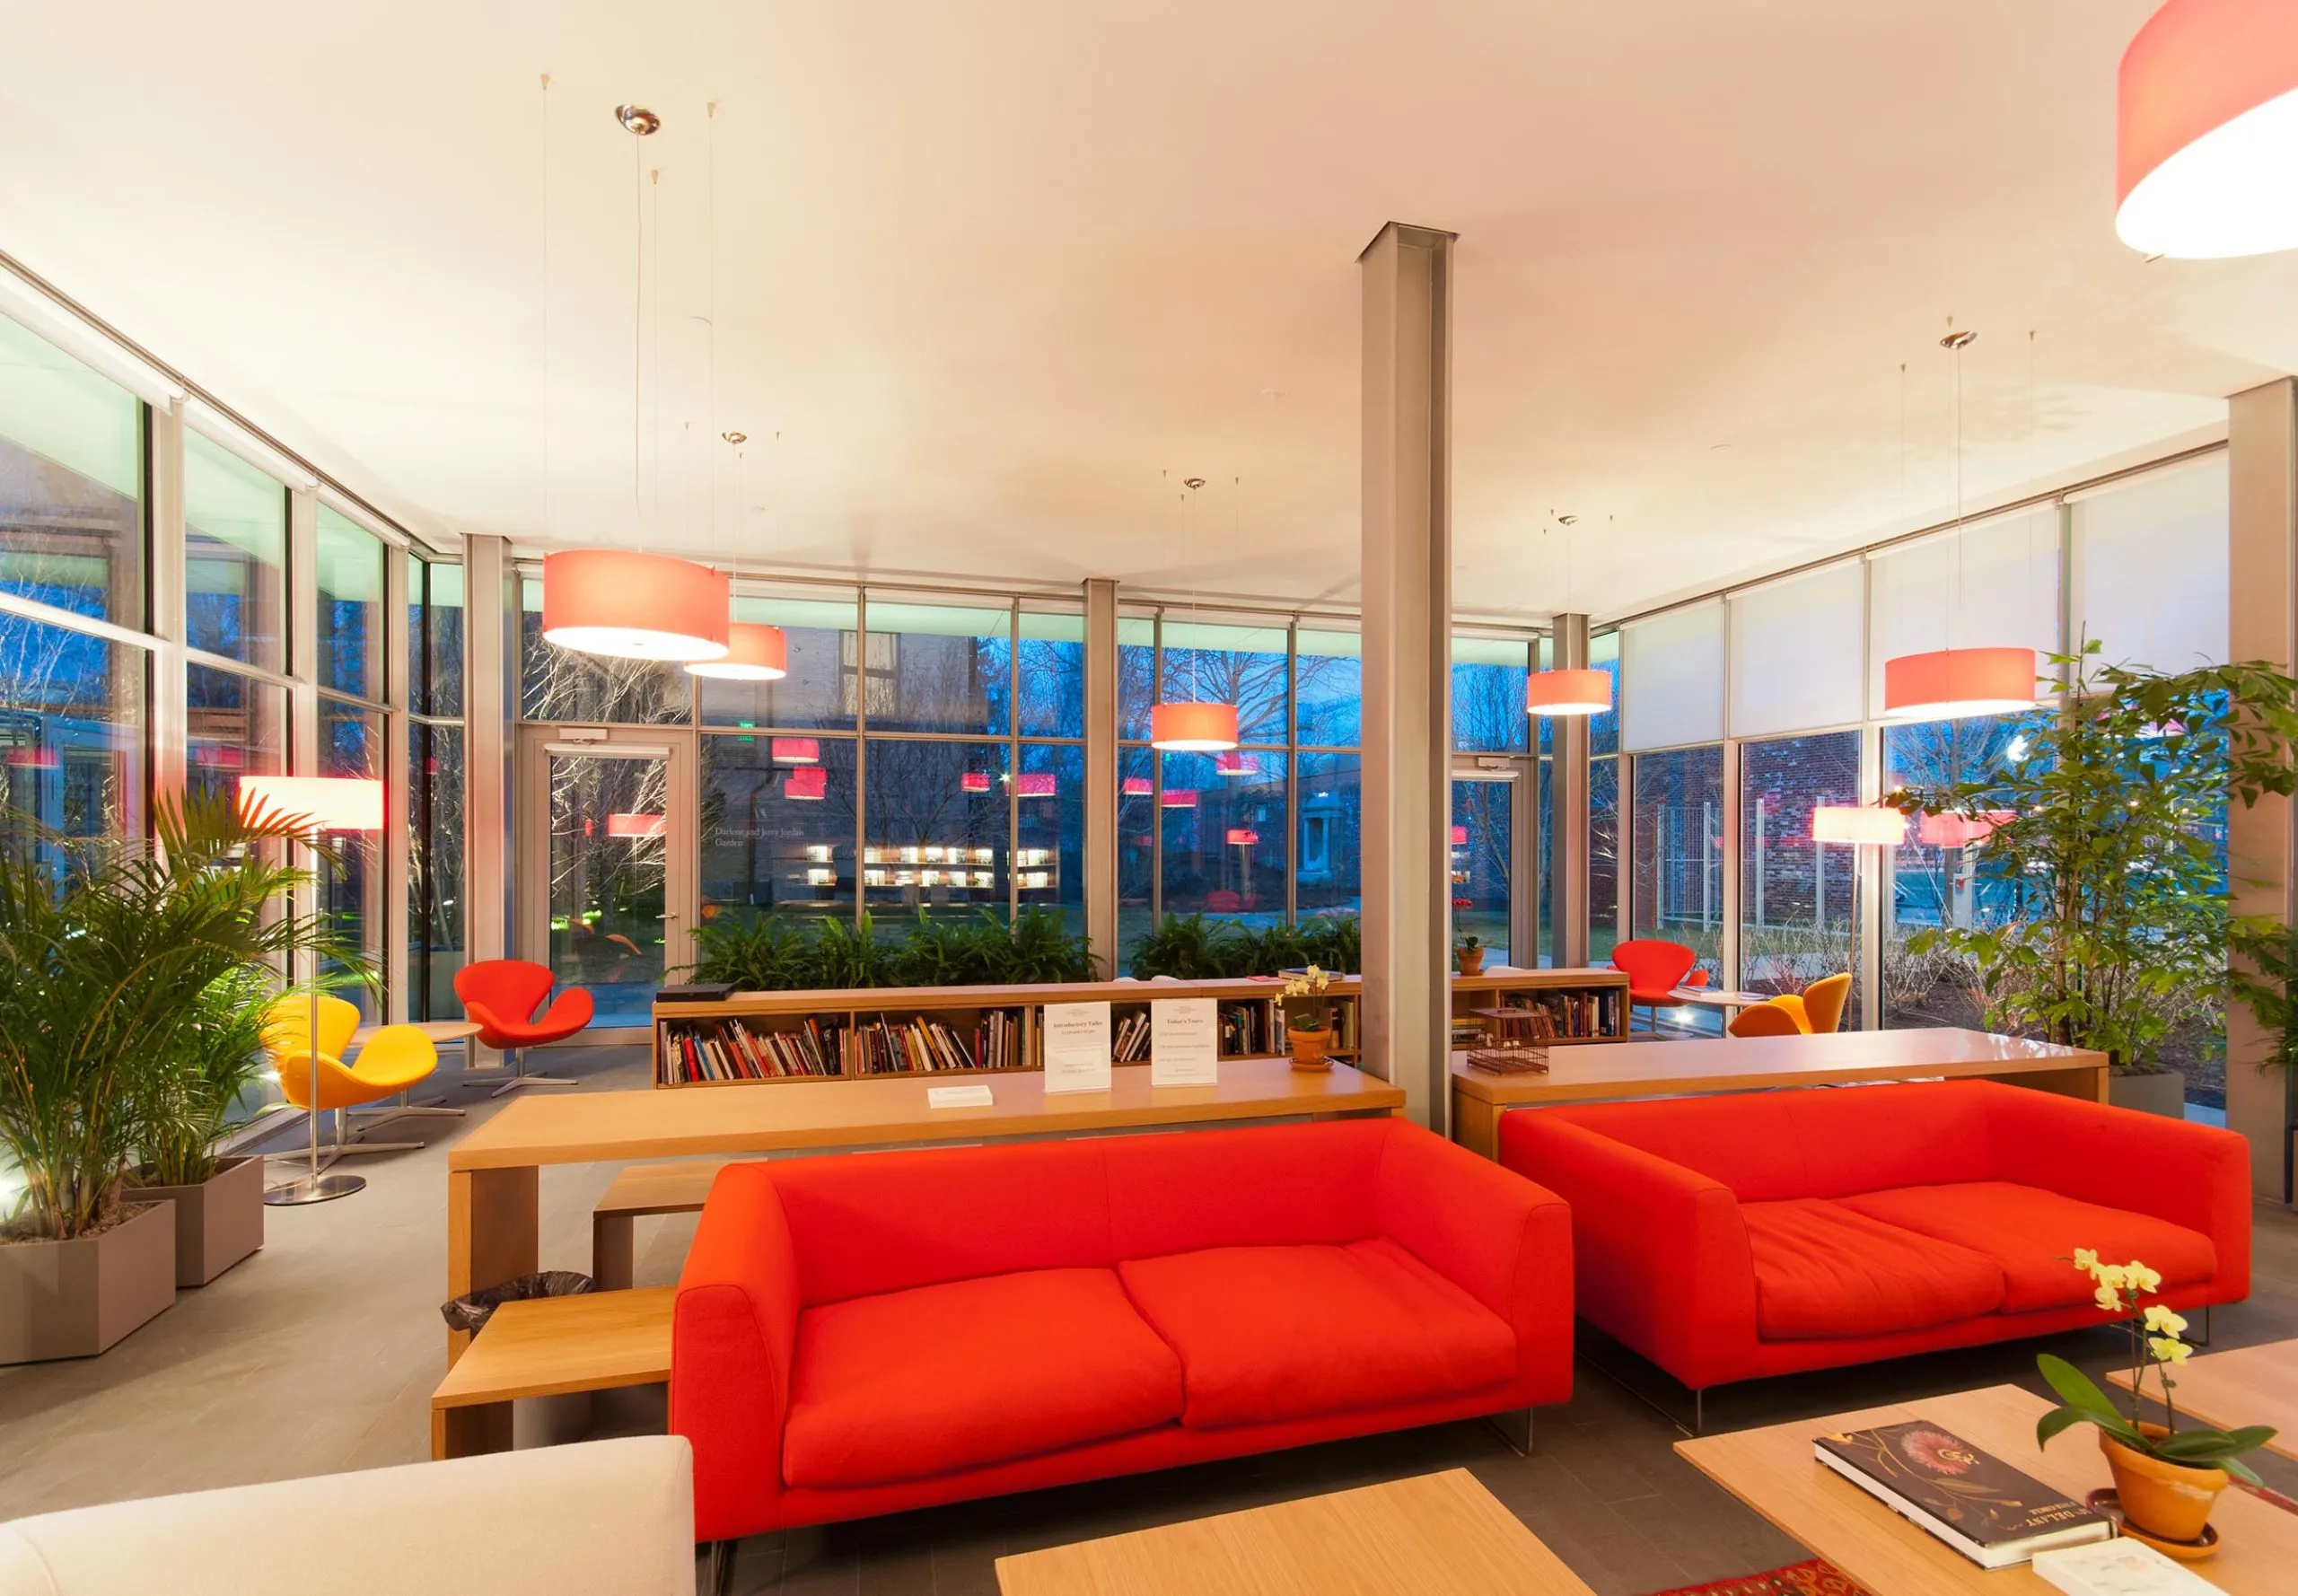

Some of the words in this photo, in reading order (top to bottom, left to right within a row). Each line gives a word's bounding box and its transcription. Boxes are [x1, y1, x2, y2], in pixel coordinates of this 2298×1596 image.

[715, 827, 743, 836] Darlene
[746, 828, 759, 836] and
[759, 828, 779, 839] Jerry
[779, 828, 804, 839] Jordan
[715, 838, 743, 847] Garden
[2025, 1510, 2074, 1526] DELANY
